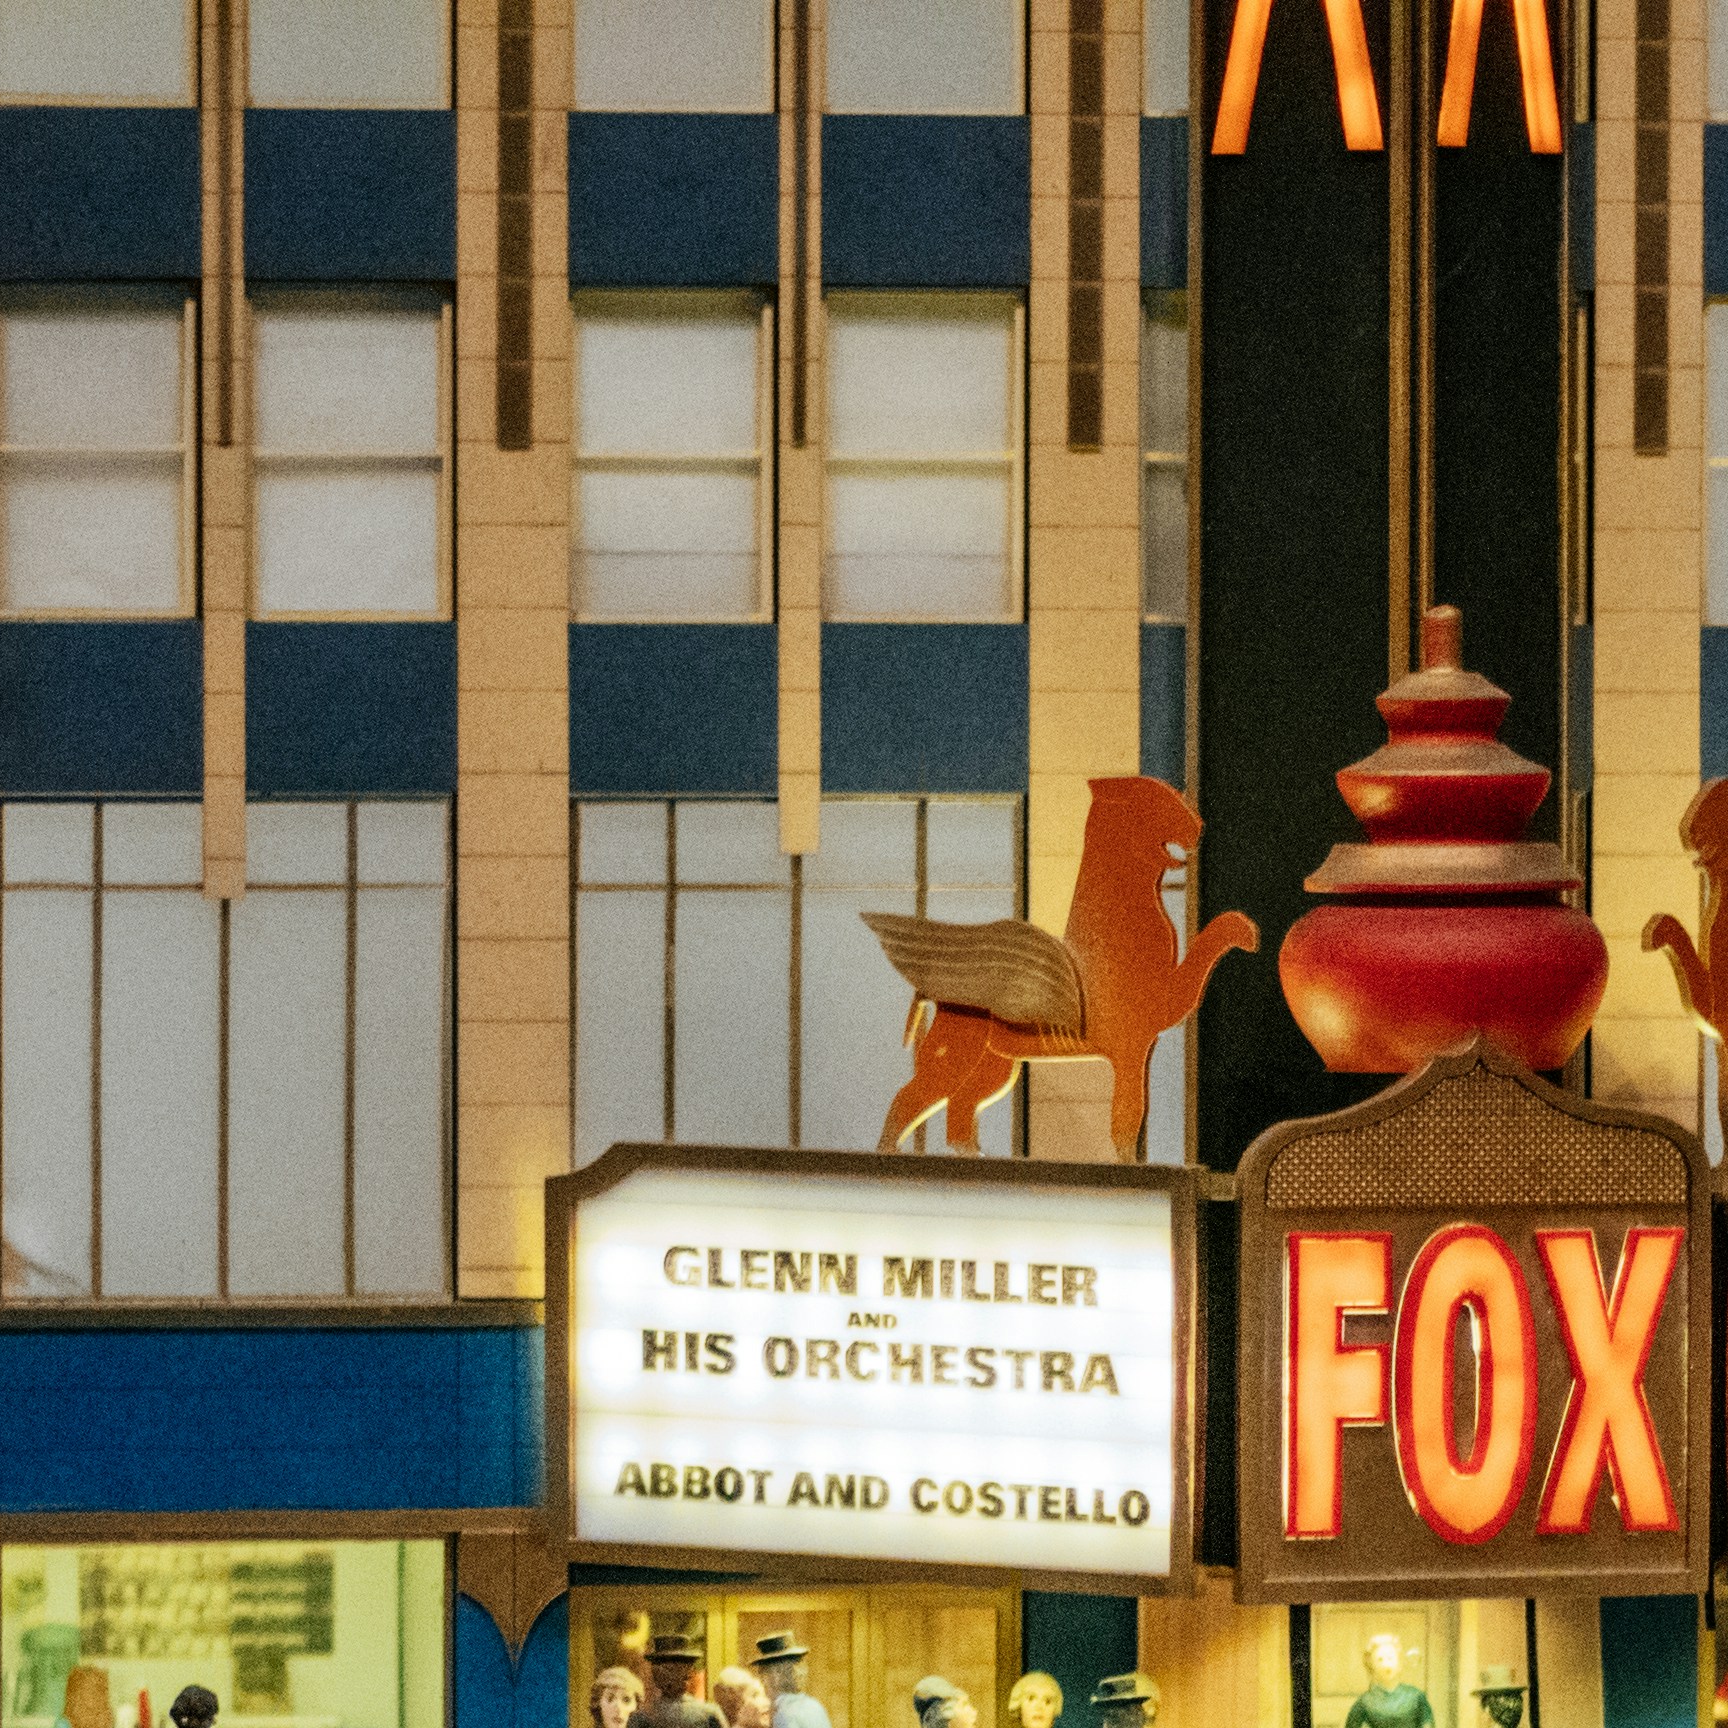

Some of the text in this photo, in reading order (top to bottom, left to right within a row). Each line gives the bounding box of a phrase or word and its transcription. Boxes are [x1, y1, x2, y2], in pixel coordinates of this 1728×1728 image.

[663, 1245, 1100, 1308] GLENN MILLER
[846, 1311, 898, 1331] AND
[640, 1328, 1120, 1397] HIS ORCHESTRA
[1284, 1223, 1685, 1545] FOX
[613, 1461, 1151, 1528] ABBOT AND COSTELLO
